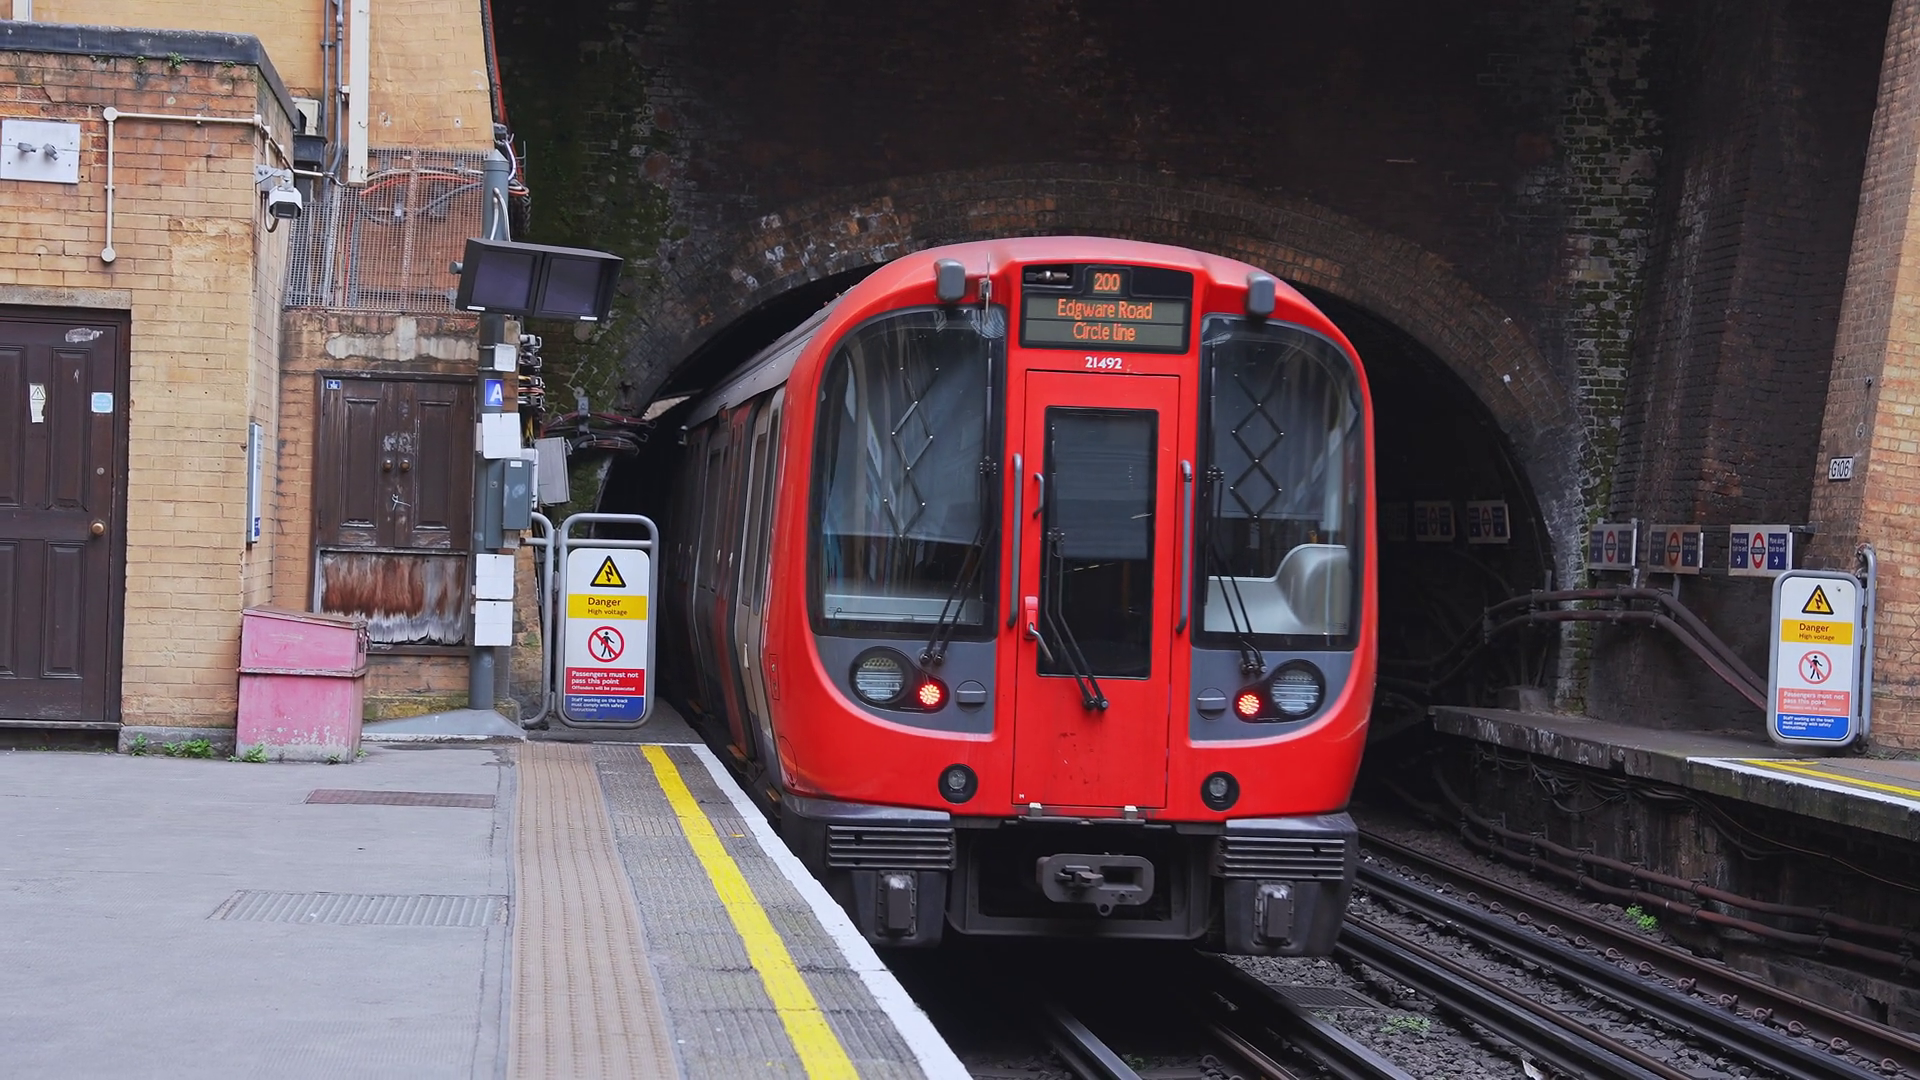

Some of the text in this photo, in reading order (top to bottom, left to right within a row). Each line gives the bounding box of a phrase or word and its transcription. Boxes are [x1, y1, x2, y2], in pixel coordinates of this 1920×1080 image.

[1094, 273, 1121, 291] 200
[1057, 299, 1153, 320] Edgware Road
[1073, 322, 1136, 341] Circle line
[1085, 356, 1122, 369] 21492
[490, 383, 503, 402] A
[1831, 460, 1851, 477] G106
[588, 597, 621, 608] Danger
[1799, 623, 1830, 633] Danger
